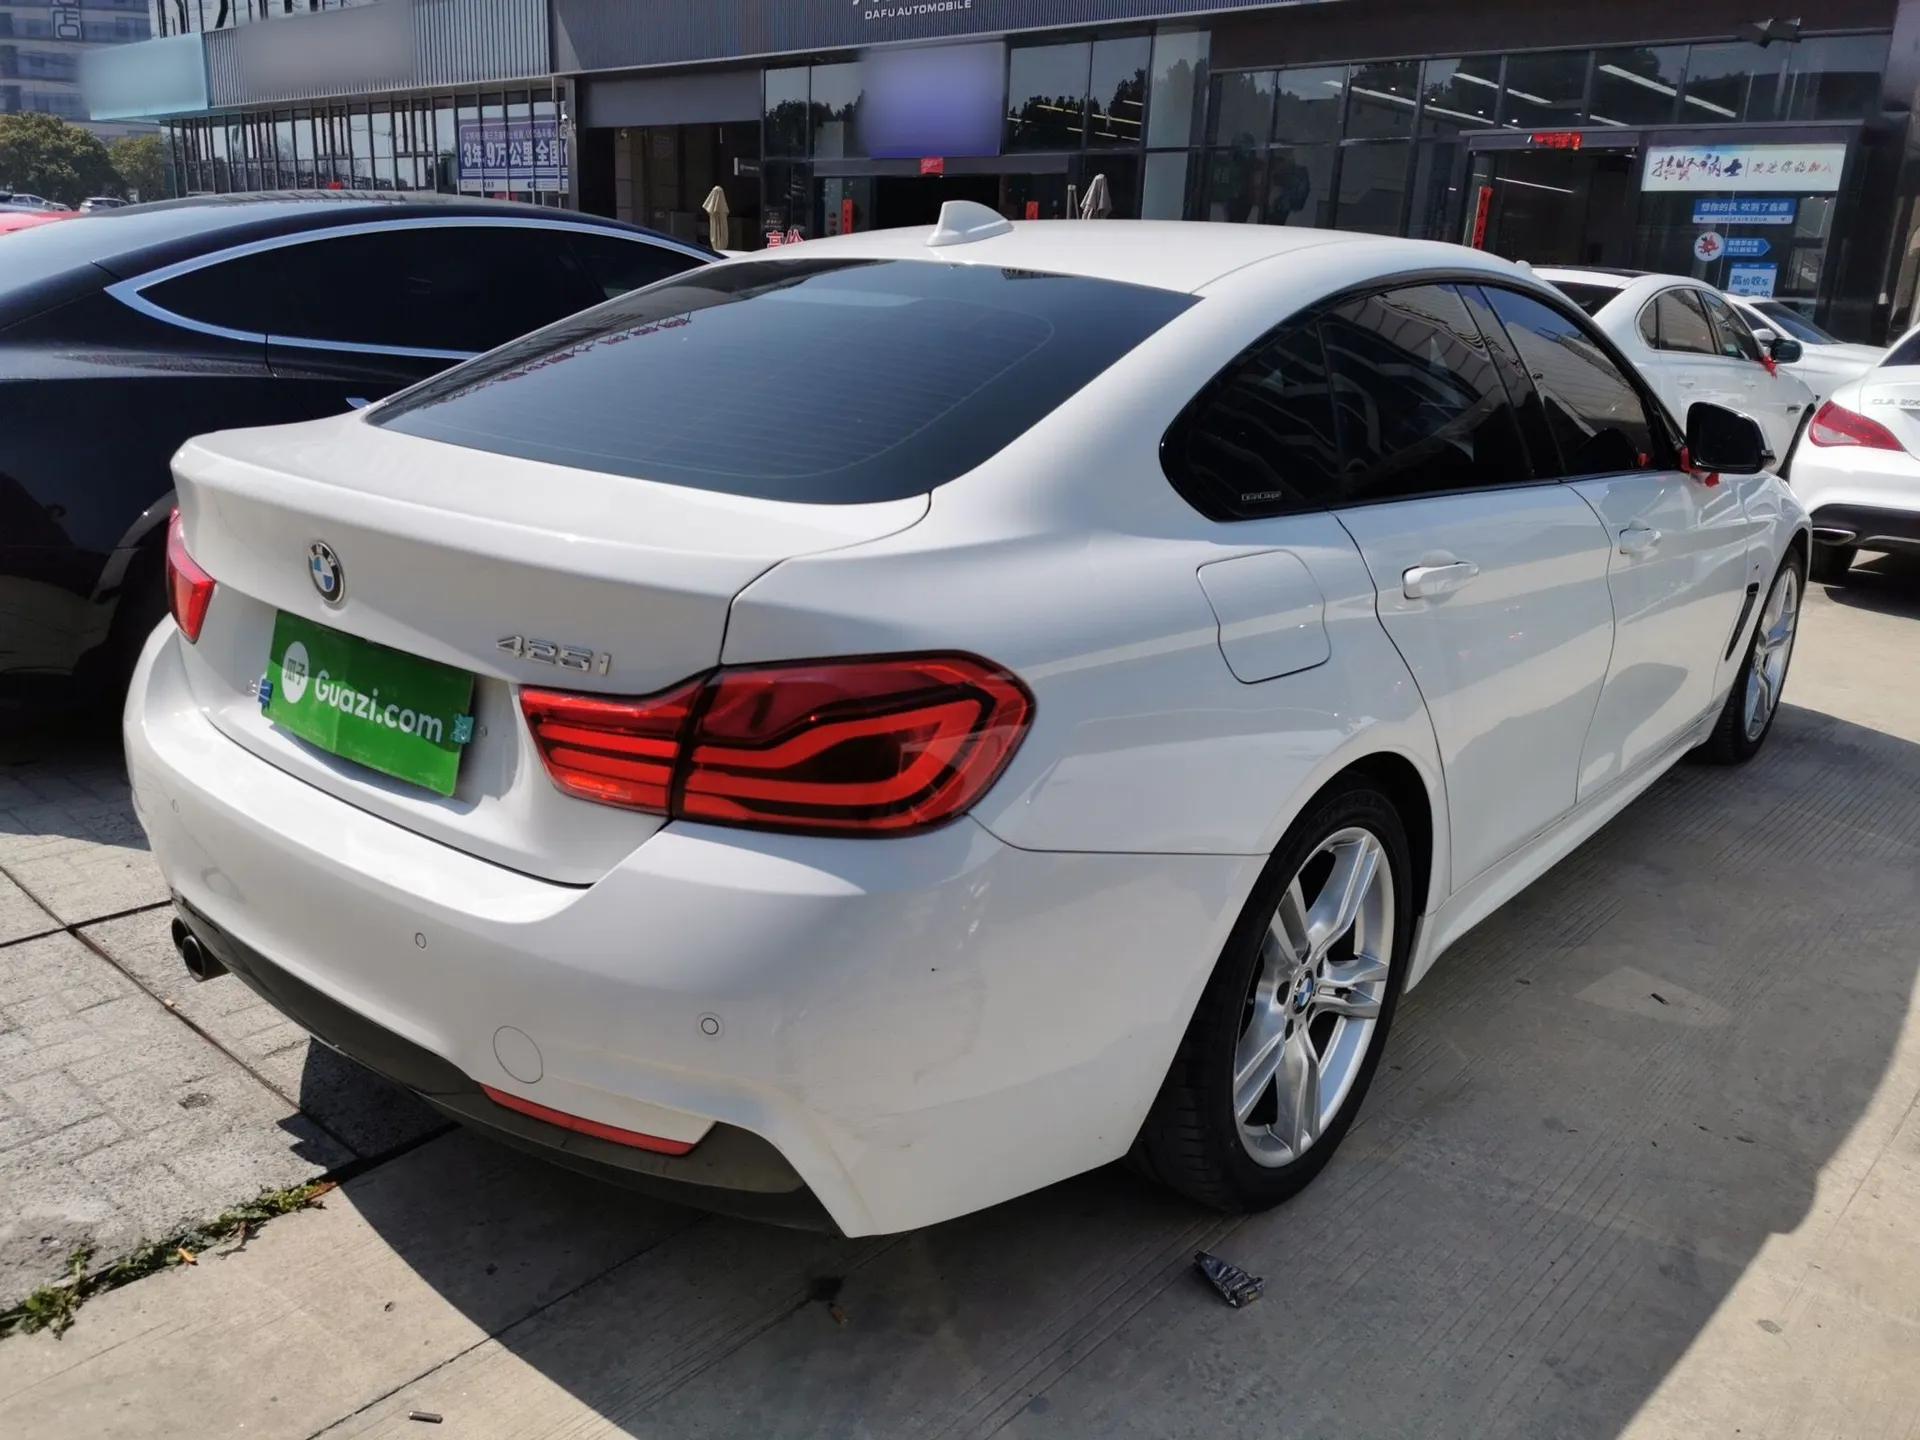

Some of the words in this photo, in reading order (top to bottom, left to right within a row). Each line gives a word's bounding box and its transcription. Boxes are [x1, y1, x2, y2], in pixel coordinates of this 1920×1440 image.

[51, 0, 81, 40] 店
[865, 8, 895, 20] DAFU
[896, 0, 972, 17] AUTOMOBILE
[284, 658, 306, 686] 瓜子
[315, 669, 443, 743] Guazi.com
